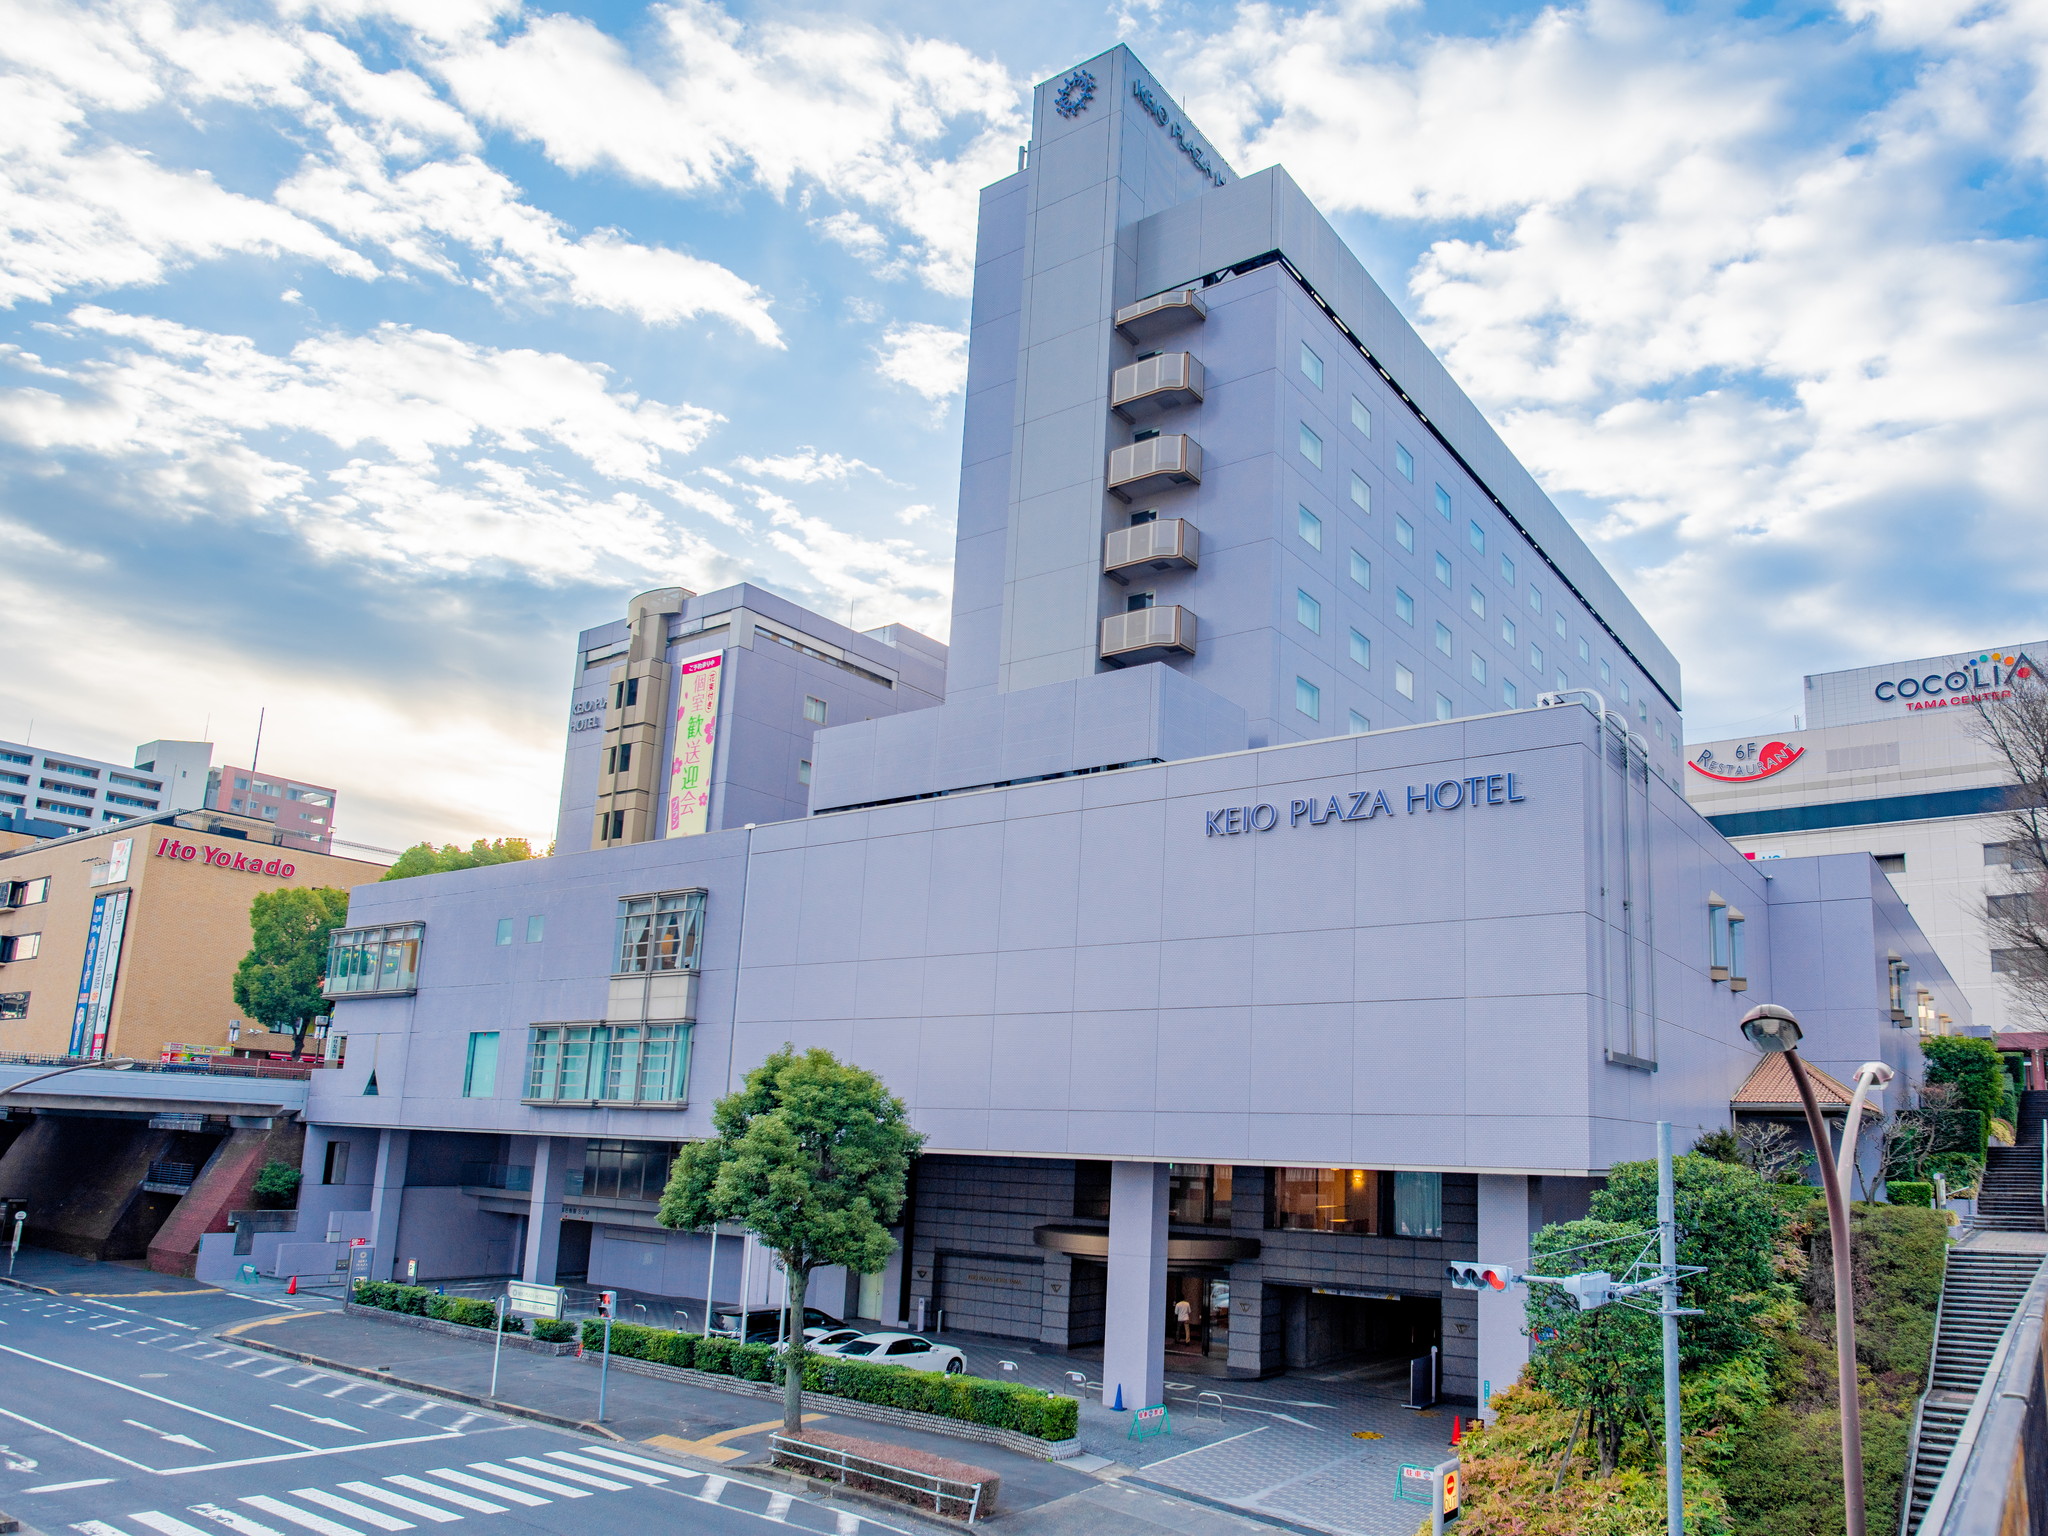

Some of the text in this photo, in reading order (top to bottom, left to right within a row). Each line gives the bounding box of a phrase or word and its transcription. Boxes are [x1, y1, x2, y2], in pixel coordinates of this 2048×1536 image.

[1133, 80, 1169, 126] KEIO
[1171, 122, 1213, 178] PLAZA
[1875, 652, 2046, 702] COCOLIA
[1906, 690, 2012, 711] TAMA CENTER
[680, 673, 706, 815] 個室歓送迎会
[1696, 742, 1798, 777] RESTAURANT
[1735, 742, 1757, 760] 6F
[1205, 772, 1524, 836] KEIO PLAZA HOTEL
[156, 837, 296, 878] Ito Yokado
